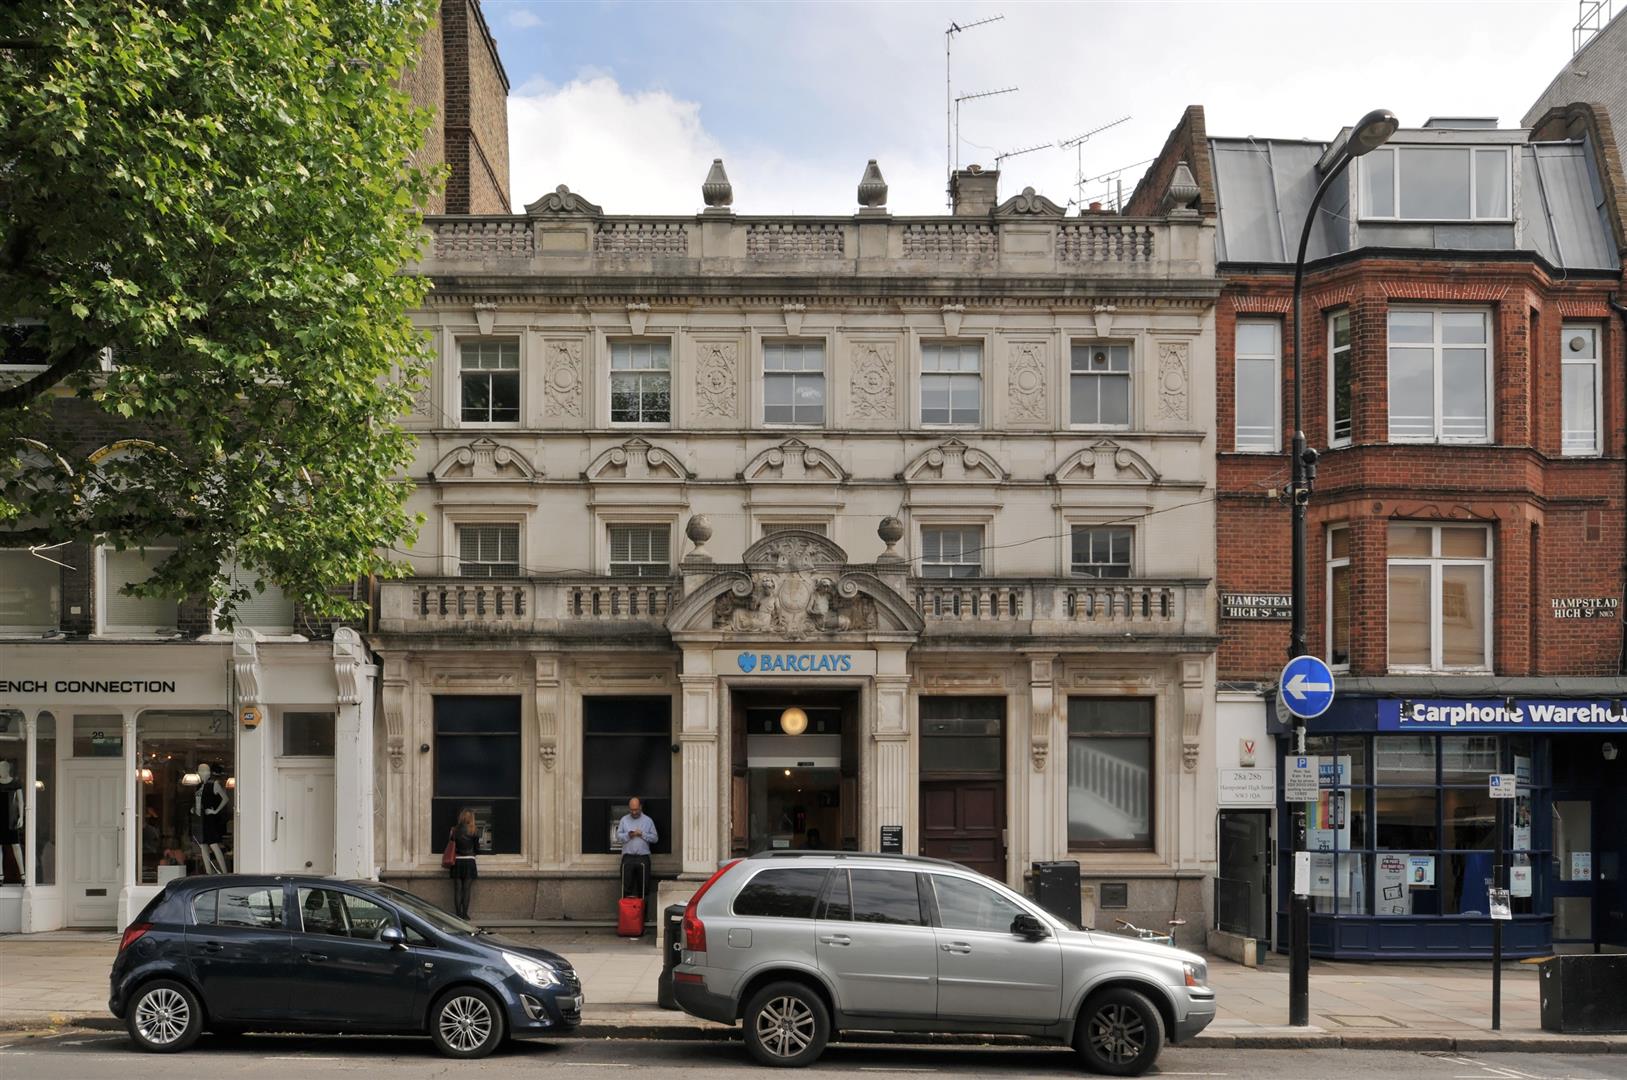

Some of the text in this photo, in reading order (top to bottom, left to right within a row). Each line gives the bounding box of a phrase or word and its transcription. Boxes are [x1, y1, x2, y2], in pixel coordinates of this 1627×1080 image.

[1227, 595, 1293, 606] HAMPSTEA
[1552, 598, 1618, 608] HAMPSTEAD
[1230, 607, 1257, 617] HIGH
[1554, 608, 1580, 618] HIGH
[760, 654, 851, 671] BARCLAYS
[0, 681, 176, 693] ENCH CONNECTION
[1412, 703, 1524, 726] Carphone
[92, 731, 104, 739] 29
